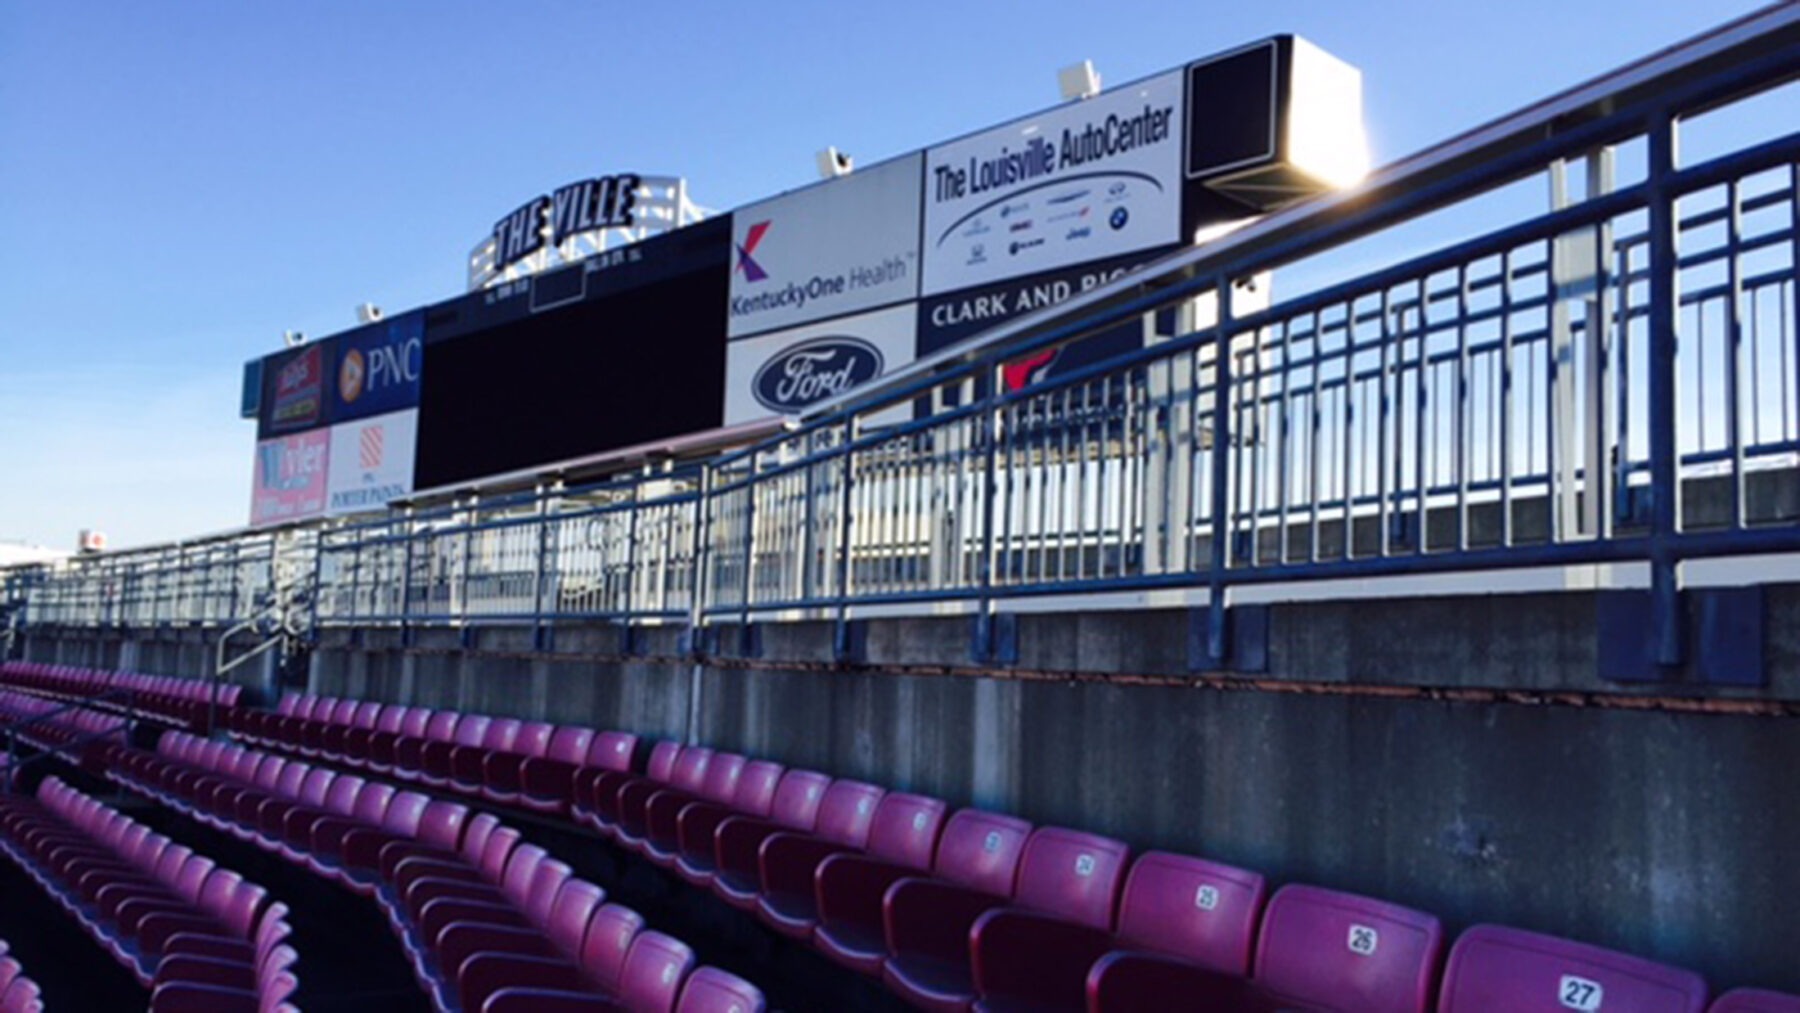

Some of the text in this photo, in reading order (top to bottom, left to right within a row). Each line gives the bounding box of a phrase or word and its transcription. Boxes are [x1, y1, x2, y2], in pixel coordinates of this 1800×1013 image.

[934, 104, 1174, 203] The Louisville AutoCenter
[495, 176, 637, 266] THE VILLE
[731, 254, 907, 317] KentuckyOne Health
[932, 292, 1008, 327] CLARK
[1015, 280, 1071, 311] AND
[366, 337, 421, 392] PNC
[775, 349, 856, 403] Ford
[1352, 928, 1373, 951] 26
[1565, 980, 1595, 1006] 27
